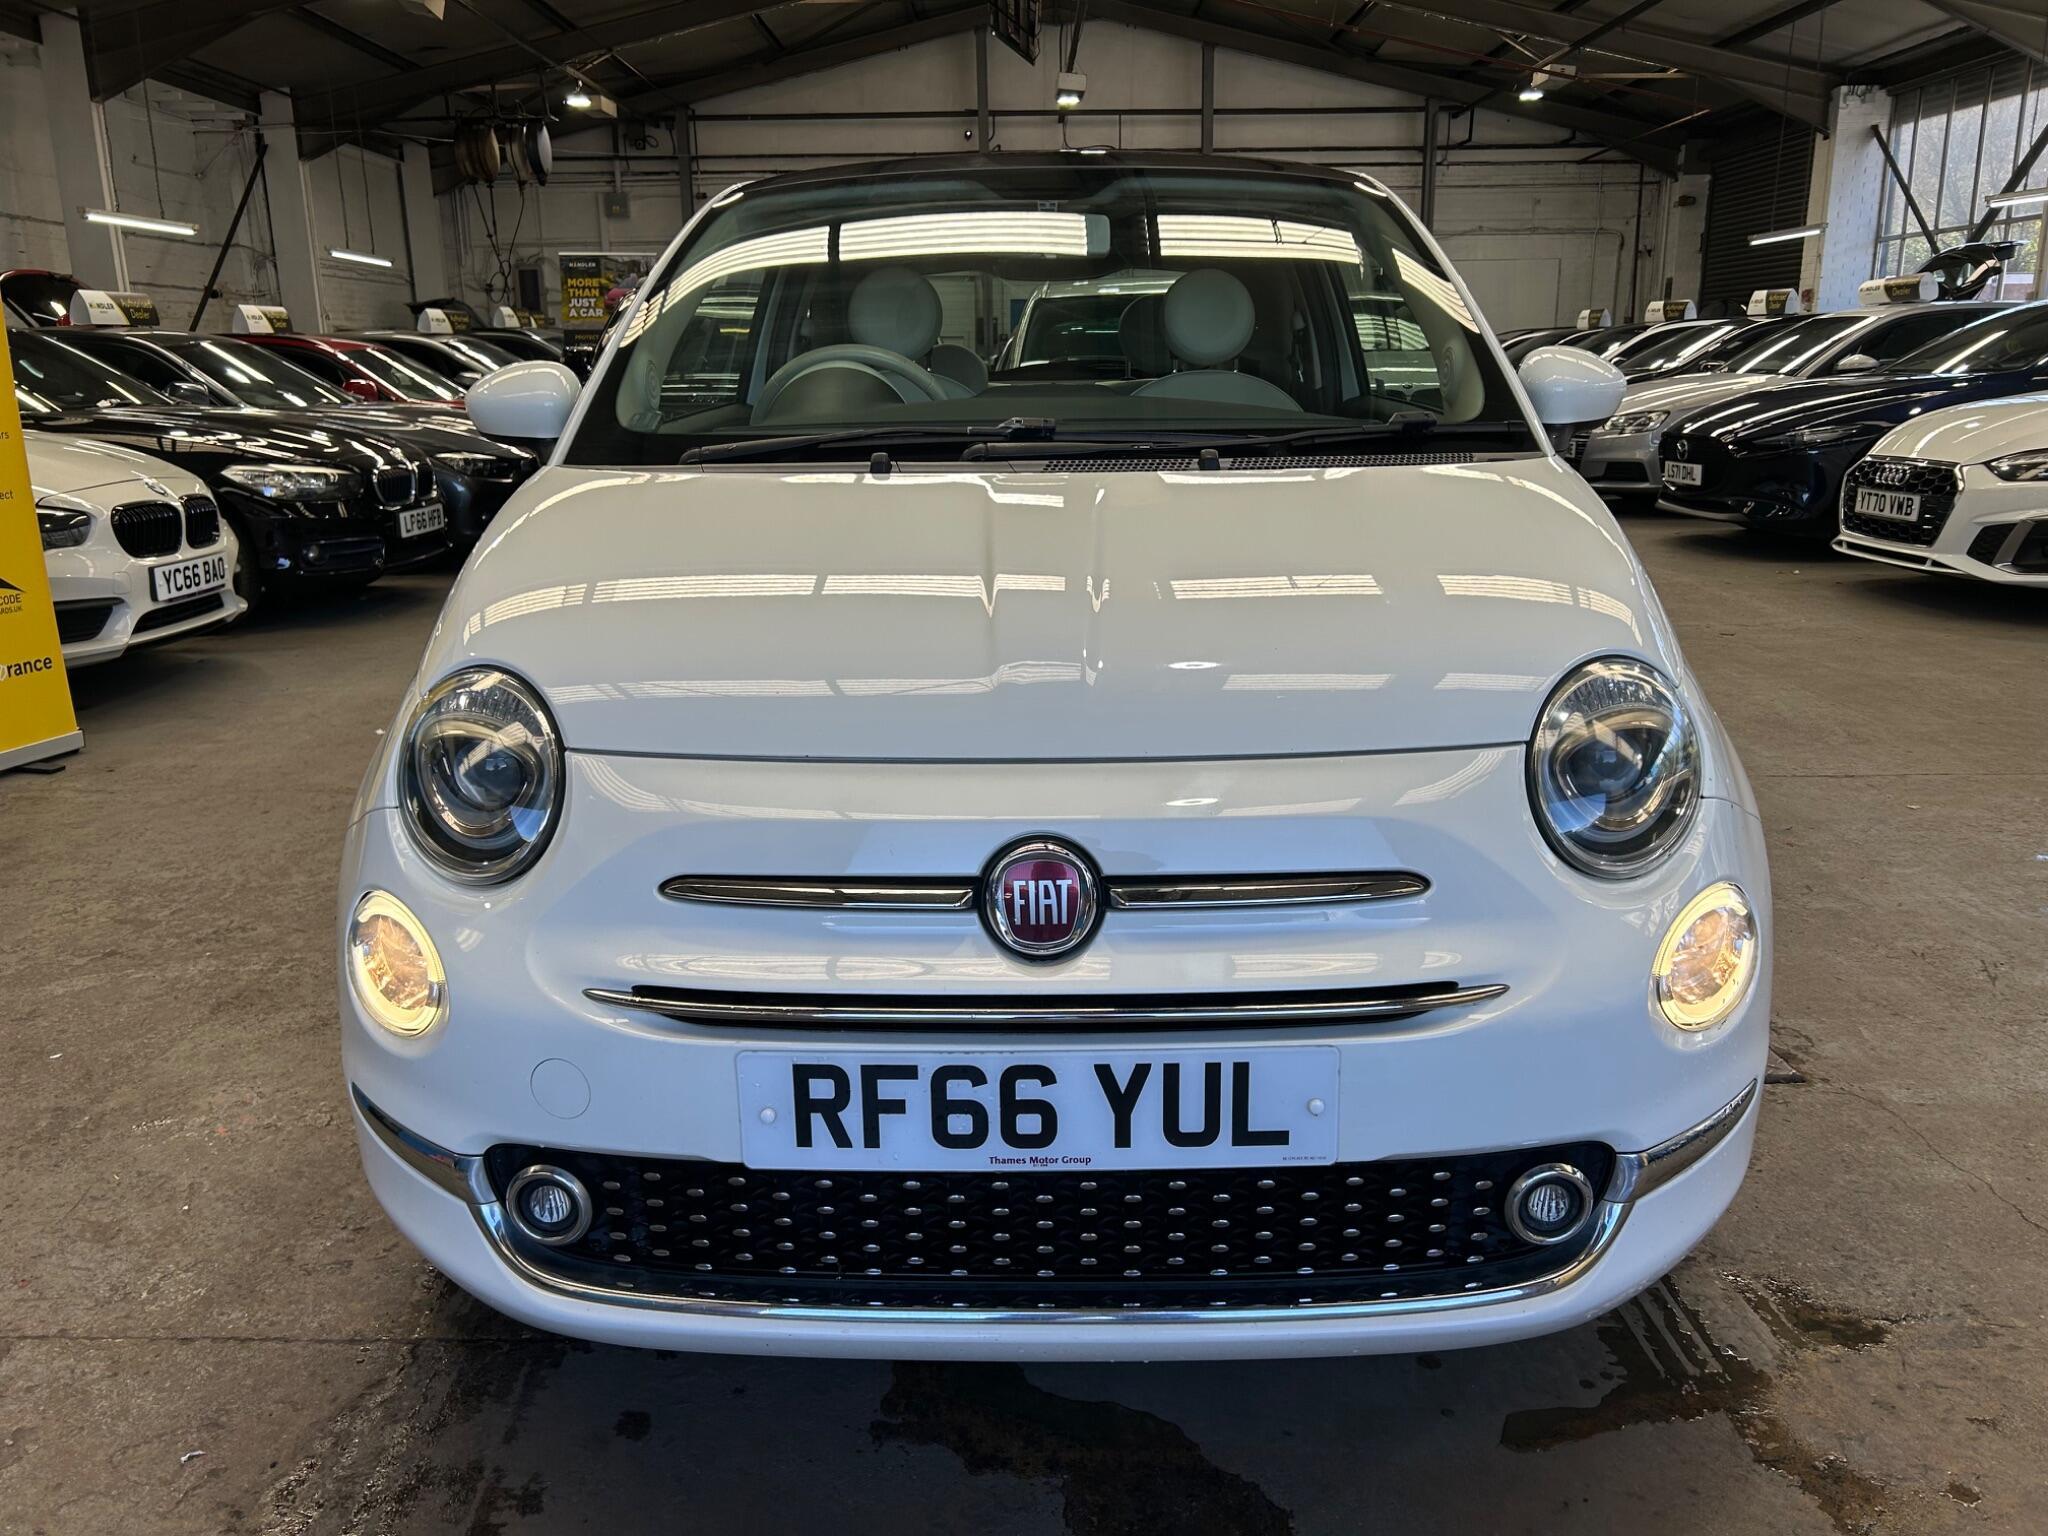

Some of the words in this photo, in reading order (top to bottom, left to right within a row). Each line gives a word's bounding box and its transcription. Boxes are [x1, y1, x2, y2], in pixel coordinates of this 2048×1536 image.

[567, 278, 600, 287] MORE
[568, 288, 600, 297] THAN
[568, 298, 597, 308] JUST
[568, 308, 578, 318] A
[580, 308, 604, 318] CAR
[1860, 490, 1887, 513] YT70
[1889, 494, 1914, 516] VWB
[162, 563, 201, 594] YC66
[1013, 879, 1073, 926] FIAT
[792, 1063, 1059, 1149] RF66
[1093, 1061, 1290, 1149] YUL
[988, 1156, 1027, 1165] Thames
[1029, 1156, 1059, 1164] Motor
[1061, 1155, 1092, 1166] Group
